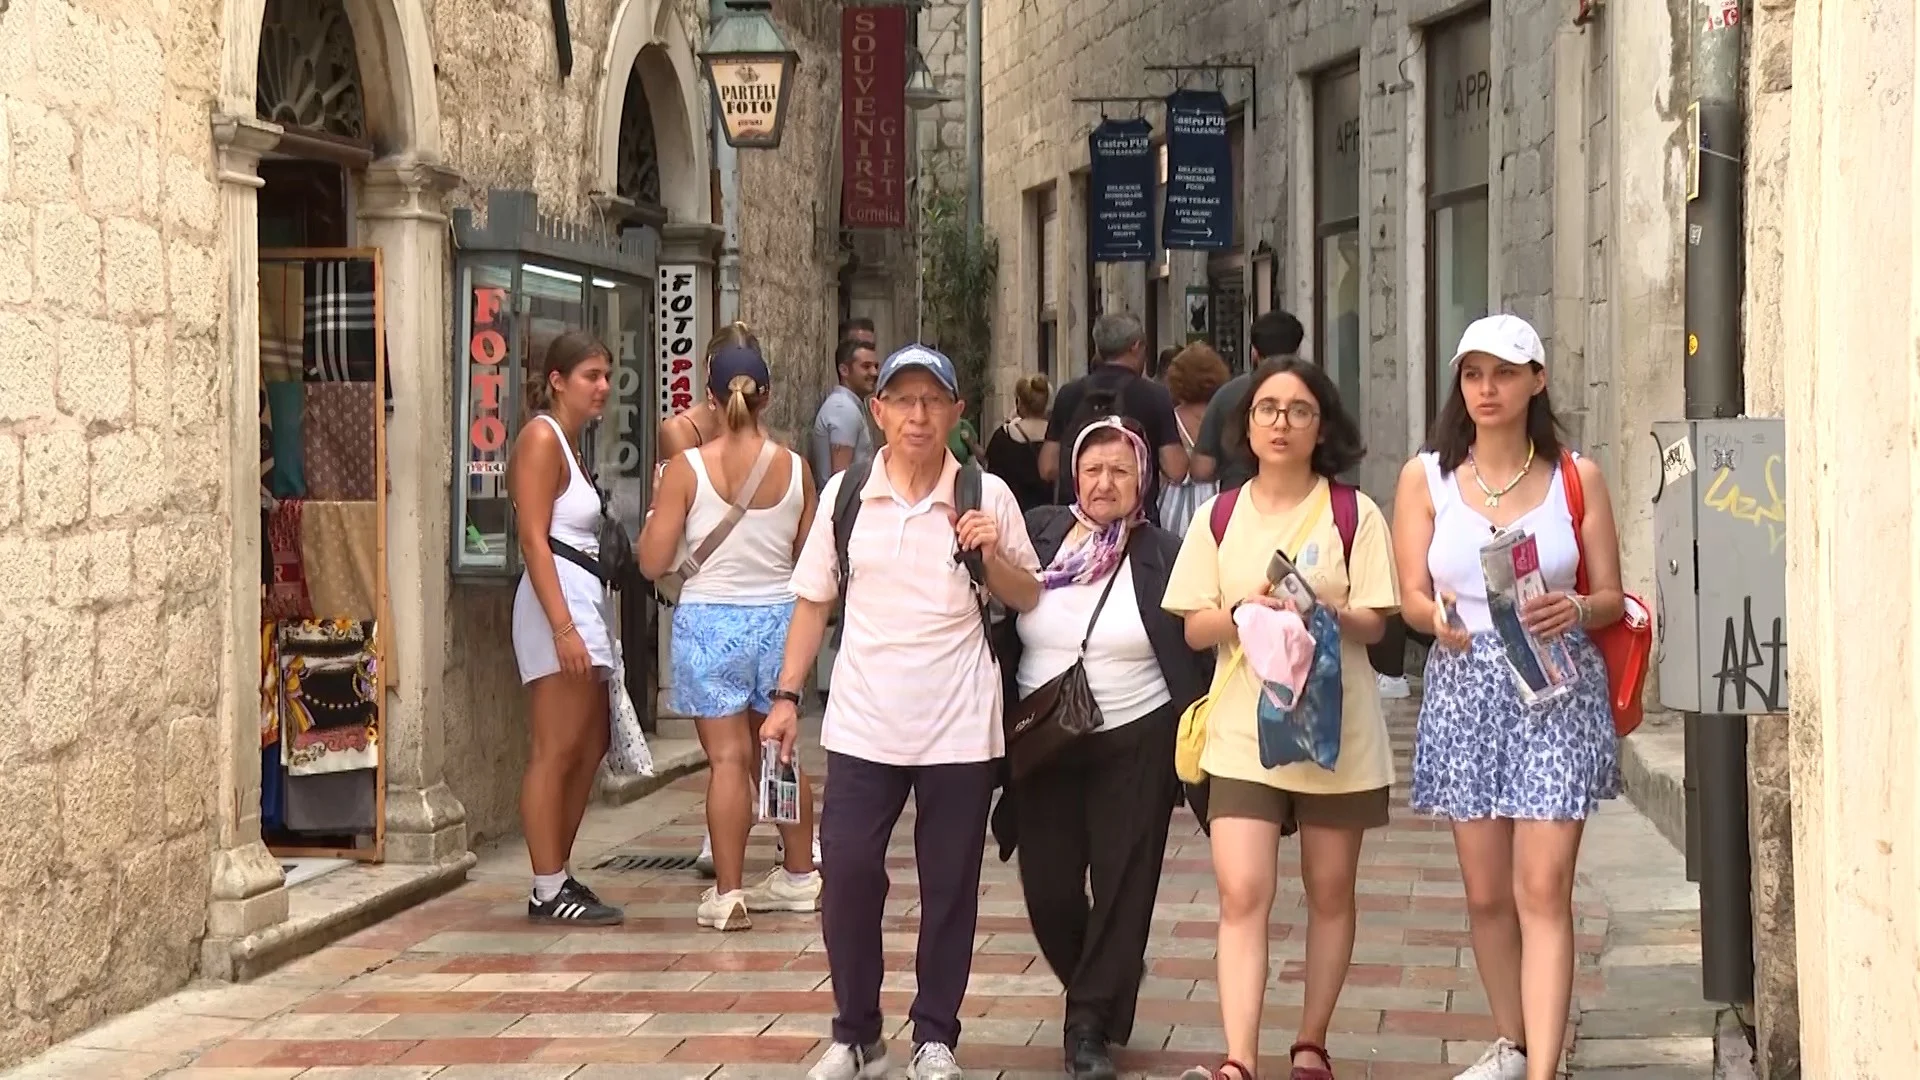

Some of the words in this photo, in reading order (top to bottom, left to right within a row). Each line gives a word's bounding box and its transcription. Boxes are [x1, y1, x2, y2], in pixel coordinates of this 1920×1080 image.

[721, 84, 776, 100] PARTELI
[726, 101, 772, 115] FOTO
[851, 13, 877, 199] SOUVENIRS
[878, 116, 898, 197] GIFT
[848, 203, 900, 223] Cornelia
[470, 288, 508, 451] FOTO
